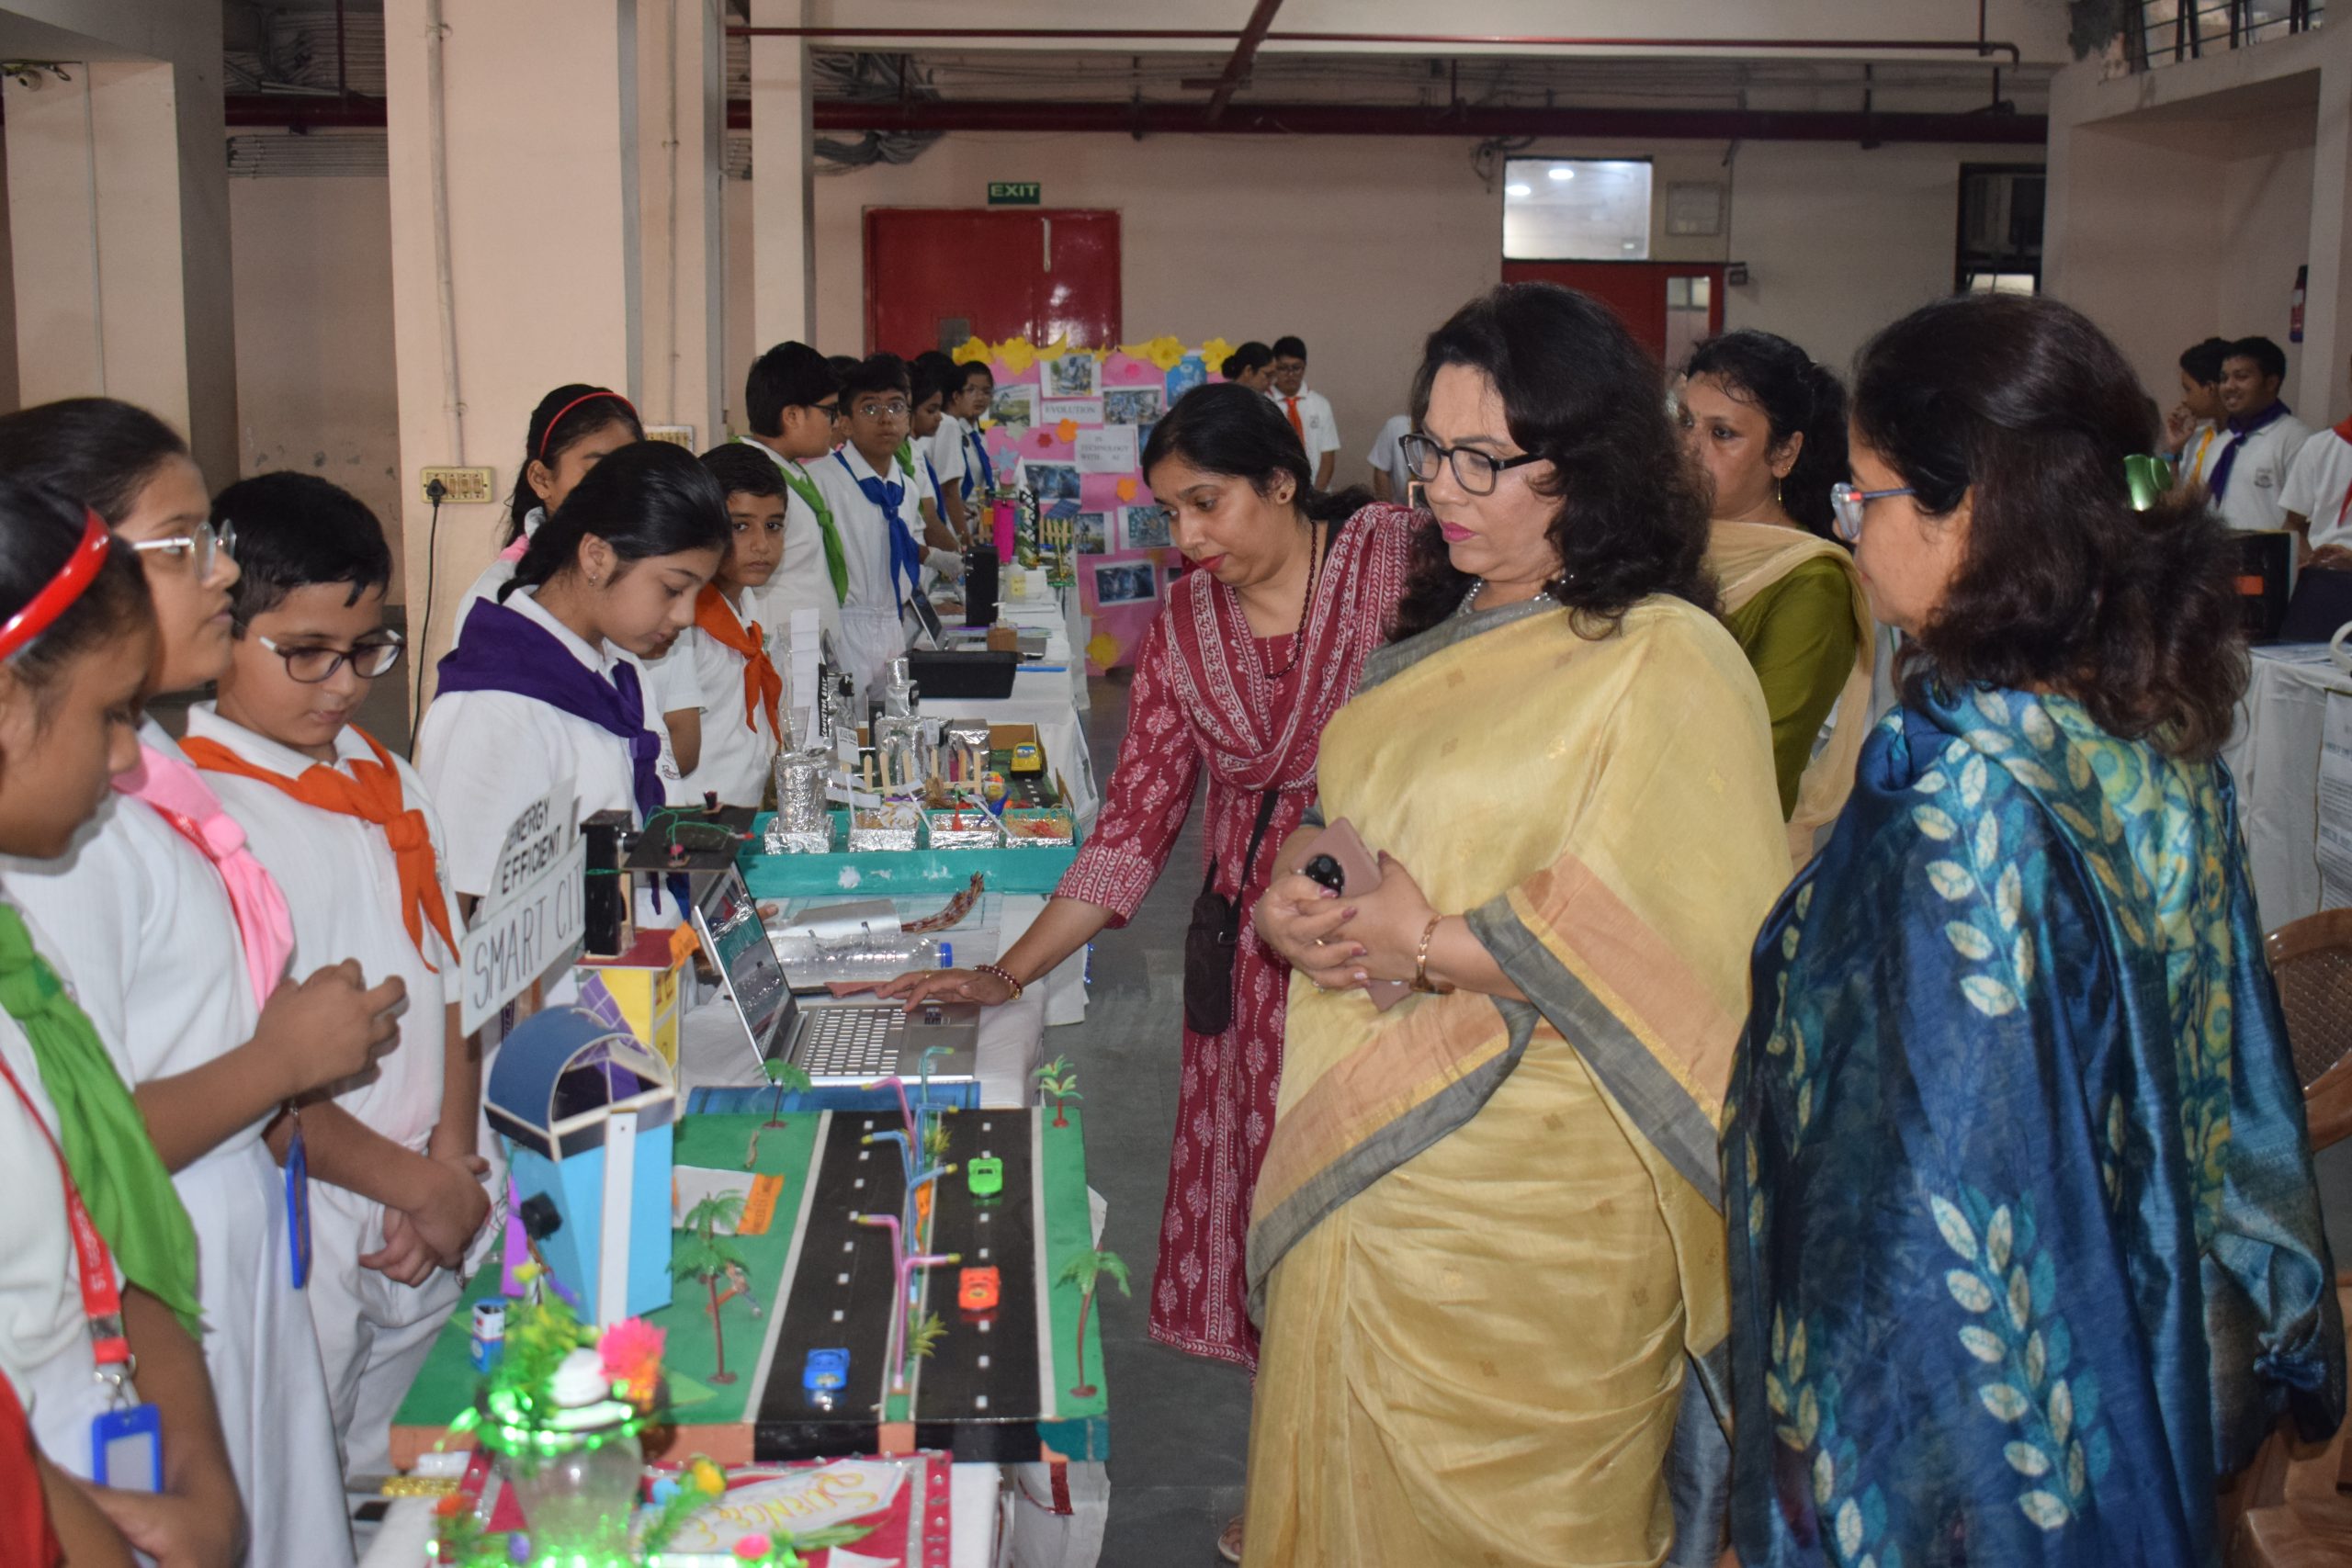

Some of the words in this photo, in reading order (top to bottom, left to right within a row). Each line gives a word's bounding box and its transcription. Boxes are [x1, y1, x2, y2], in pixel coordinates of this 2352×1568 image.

[989, 185, 1038, 197] EXIT
[1045, 405, 1096, 413] EVOLUTION
[473, 896, 548, 1010] SMART
